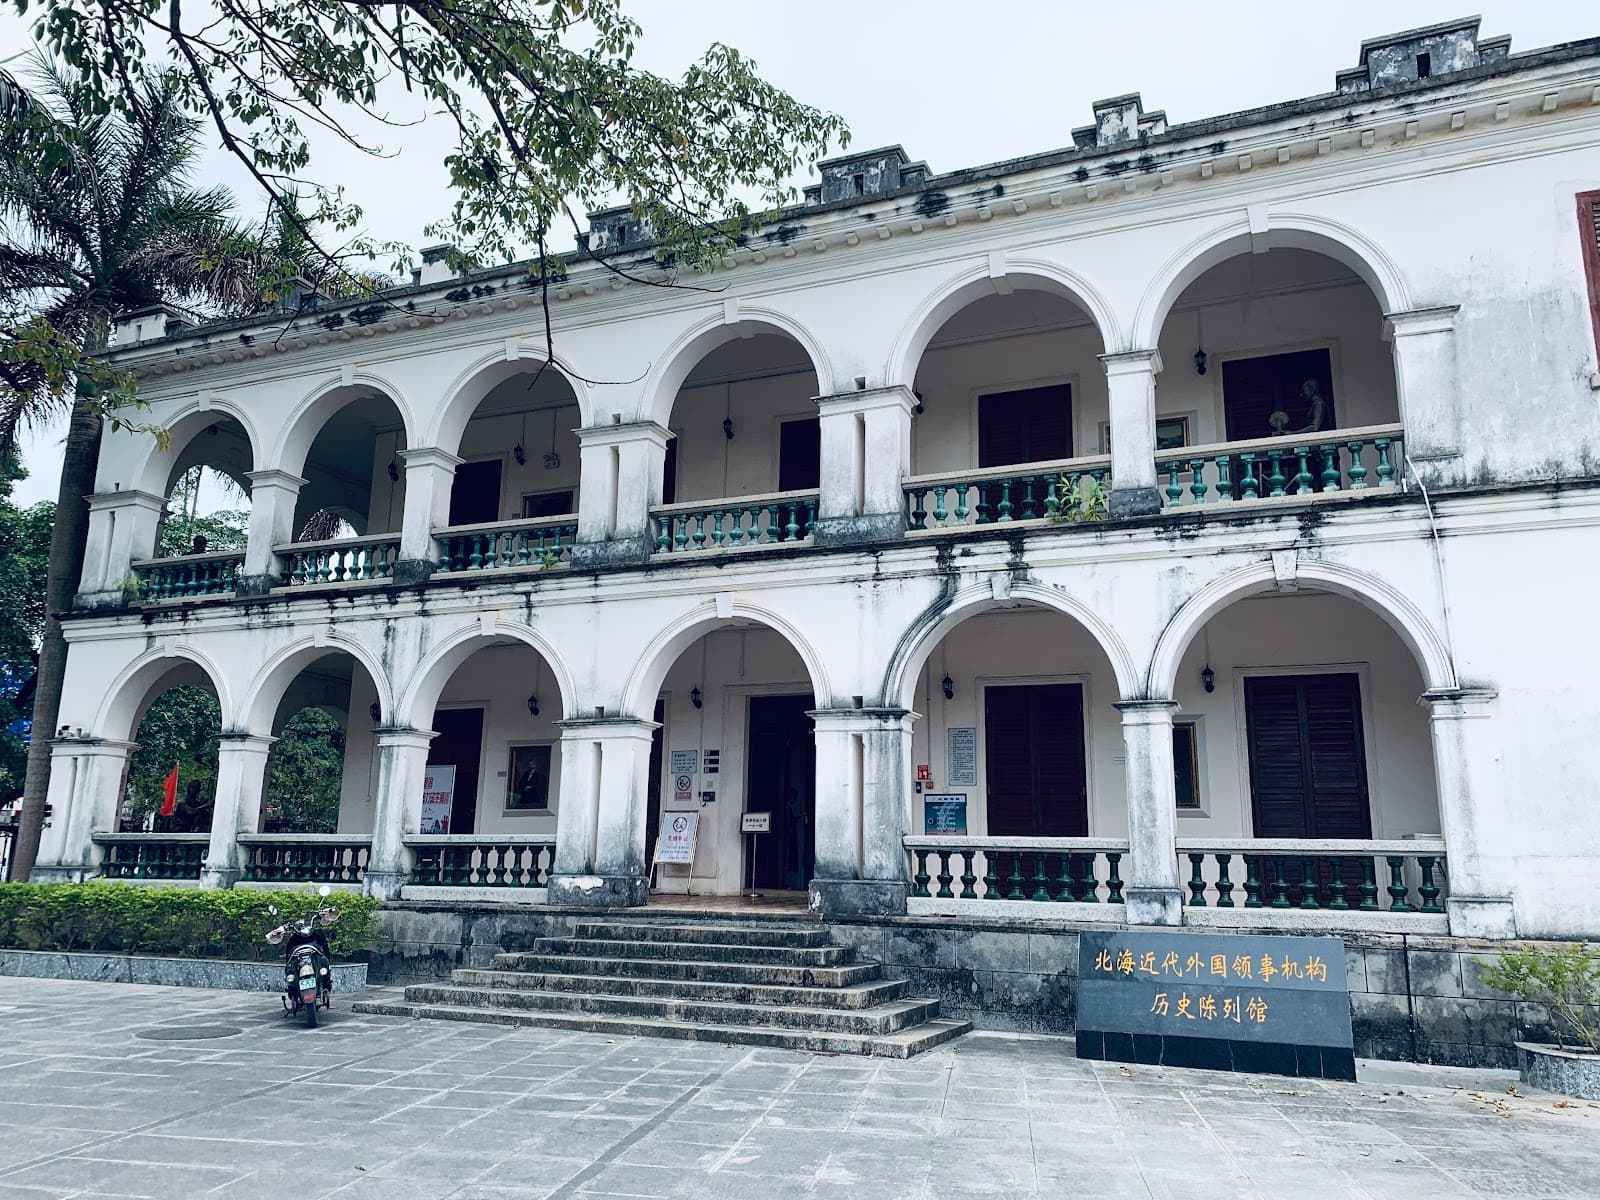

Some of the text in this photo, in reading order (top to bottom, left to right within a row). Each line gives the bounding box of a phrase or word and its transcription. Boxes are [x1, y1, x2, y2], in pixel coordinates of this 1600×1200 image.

[1094, 949, 1327, 983] 北海近代外国领事机构
[1150, 992, 1269, 1024] 历史陈列馆
